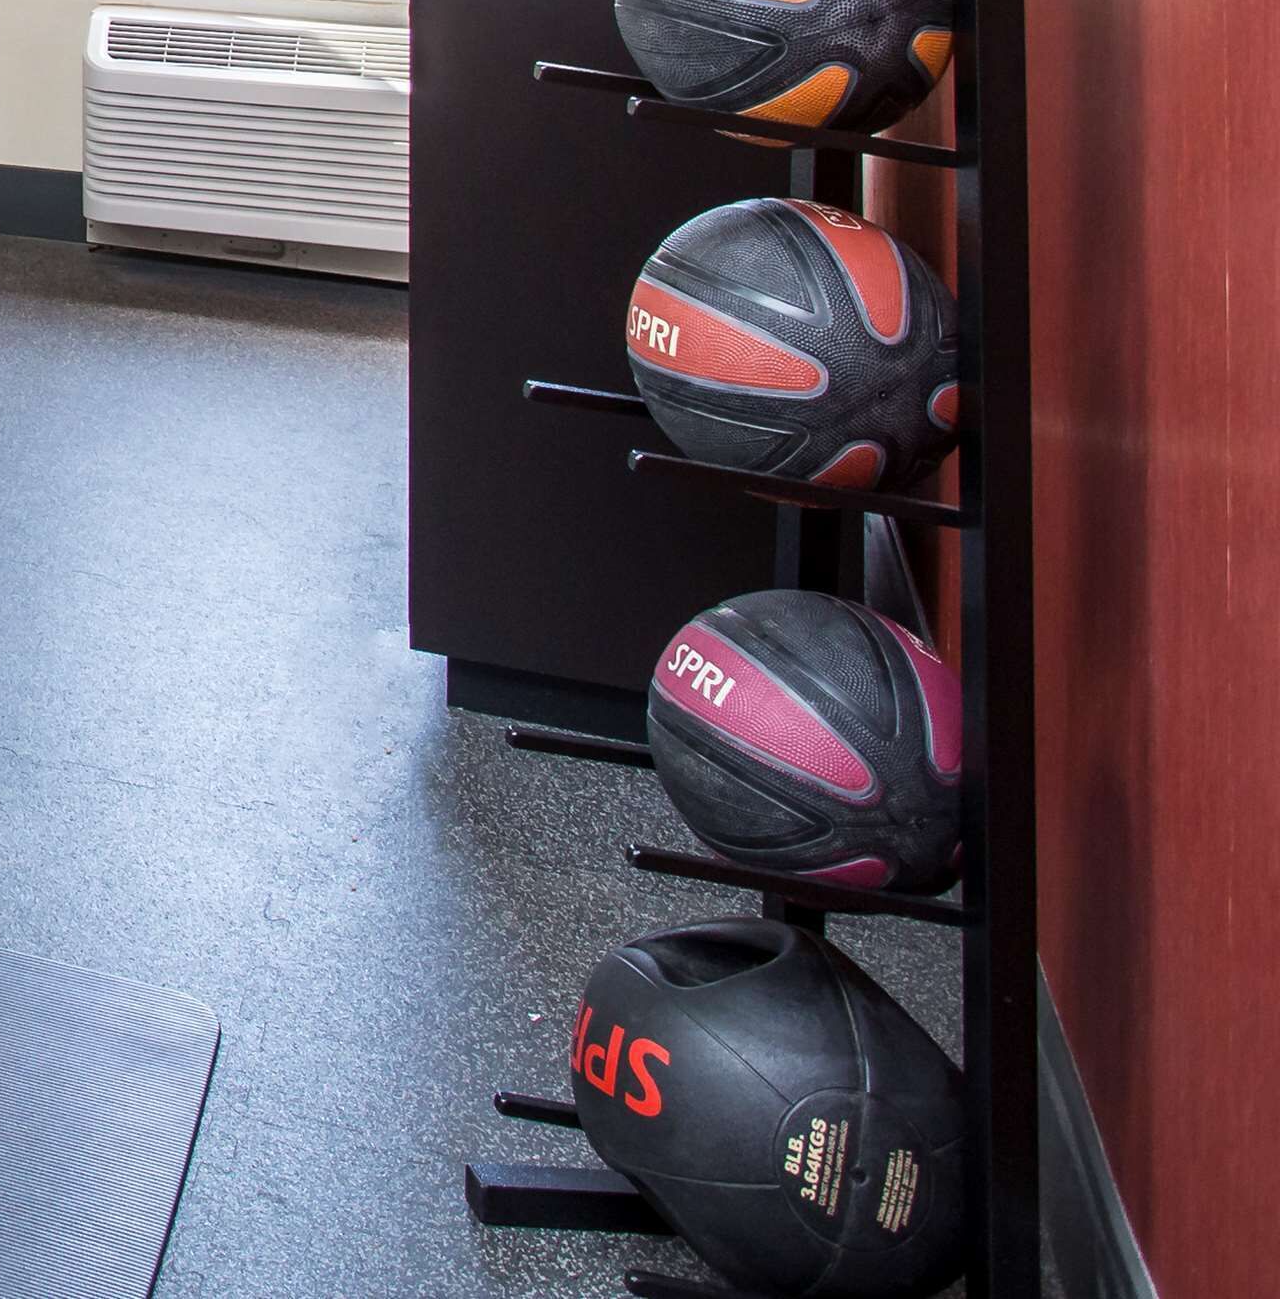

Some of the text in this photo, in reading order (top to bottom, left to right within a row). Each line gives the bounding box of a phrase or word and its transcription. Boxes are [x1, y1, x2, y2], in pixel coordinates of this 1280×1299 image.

[629, 305, 681, 357] SPRI
[667, 643, 737, 708] SPRI
[784, 1133, 805, 1175] 8LB.
[800, 1117, 828, 1201] 3.64KGS
